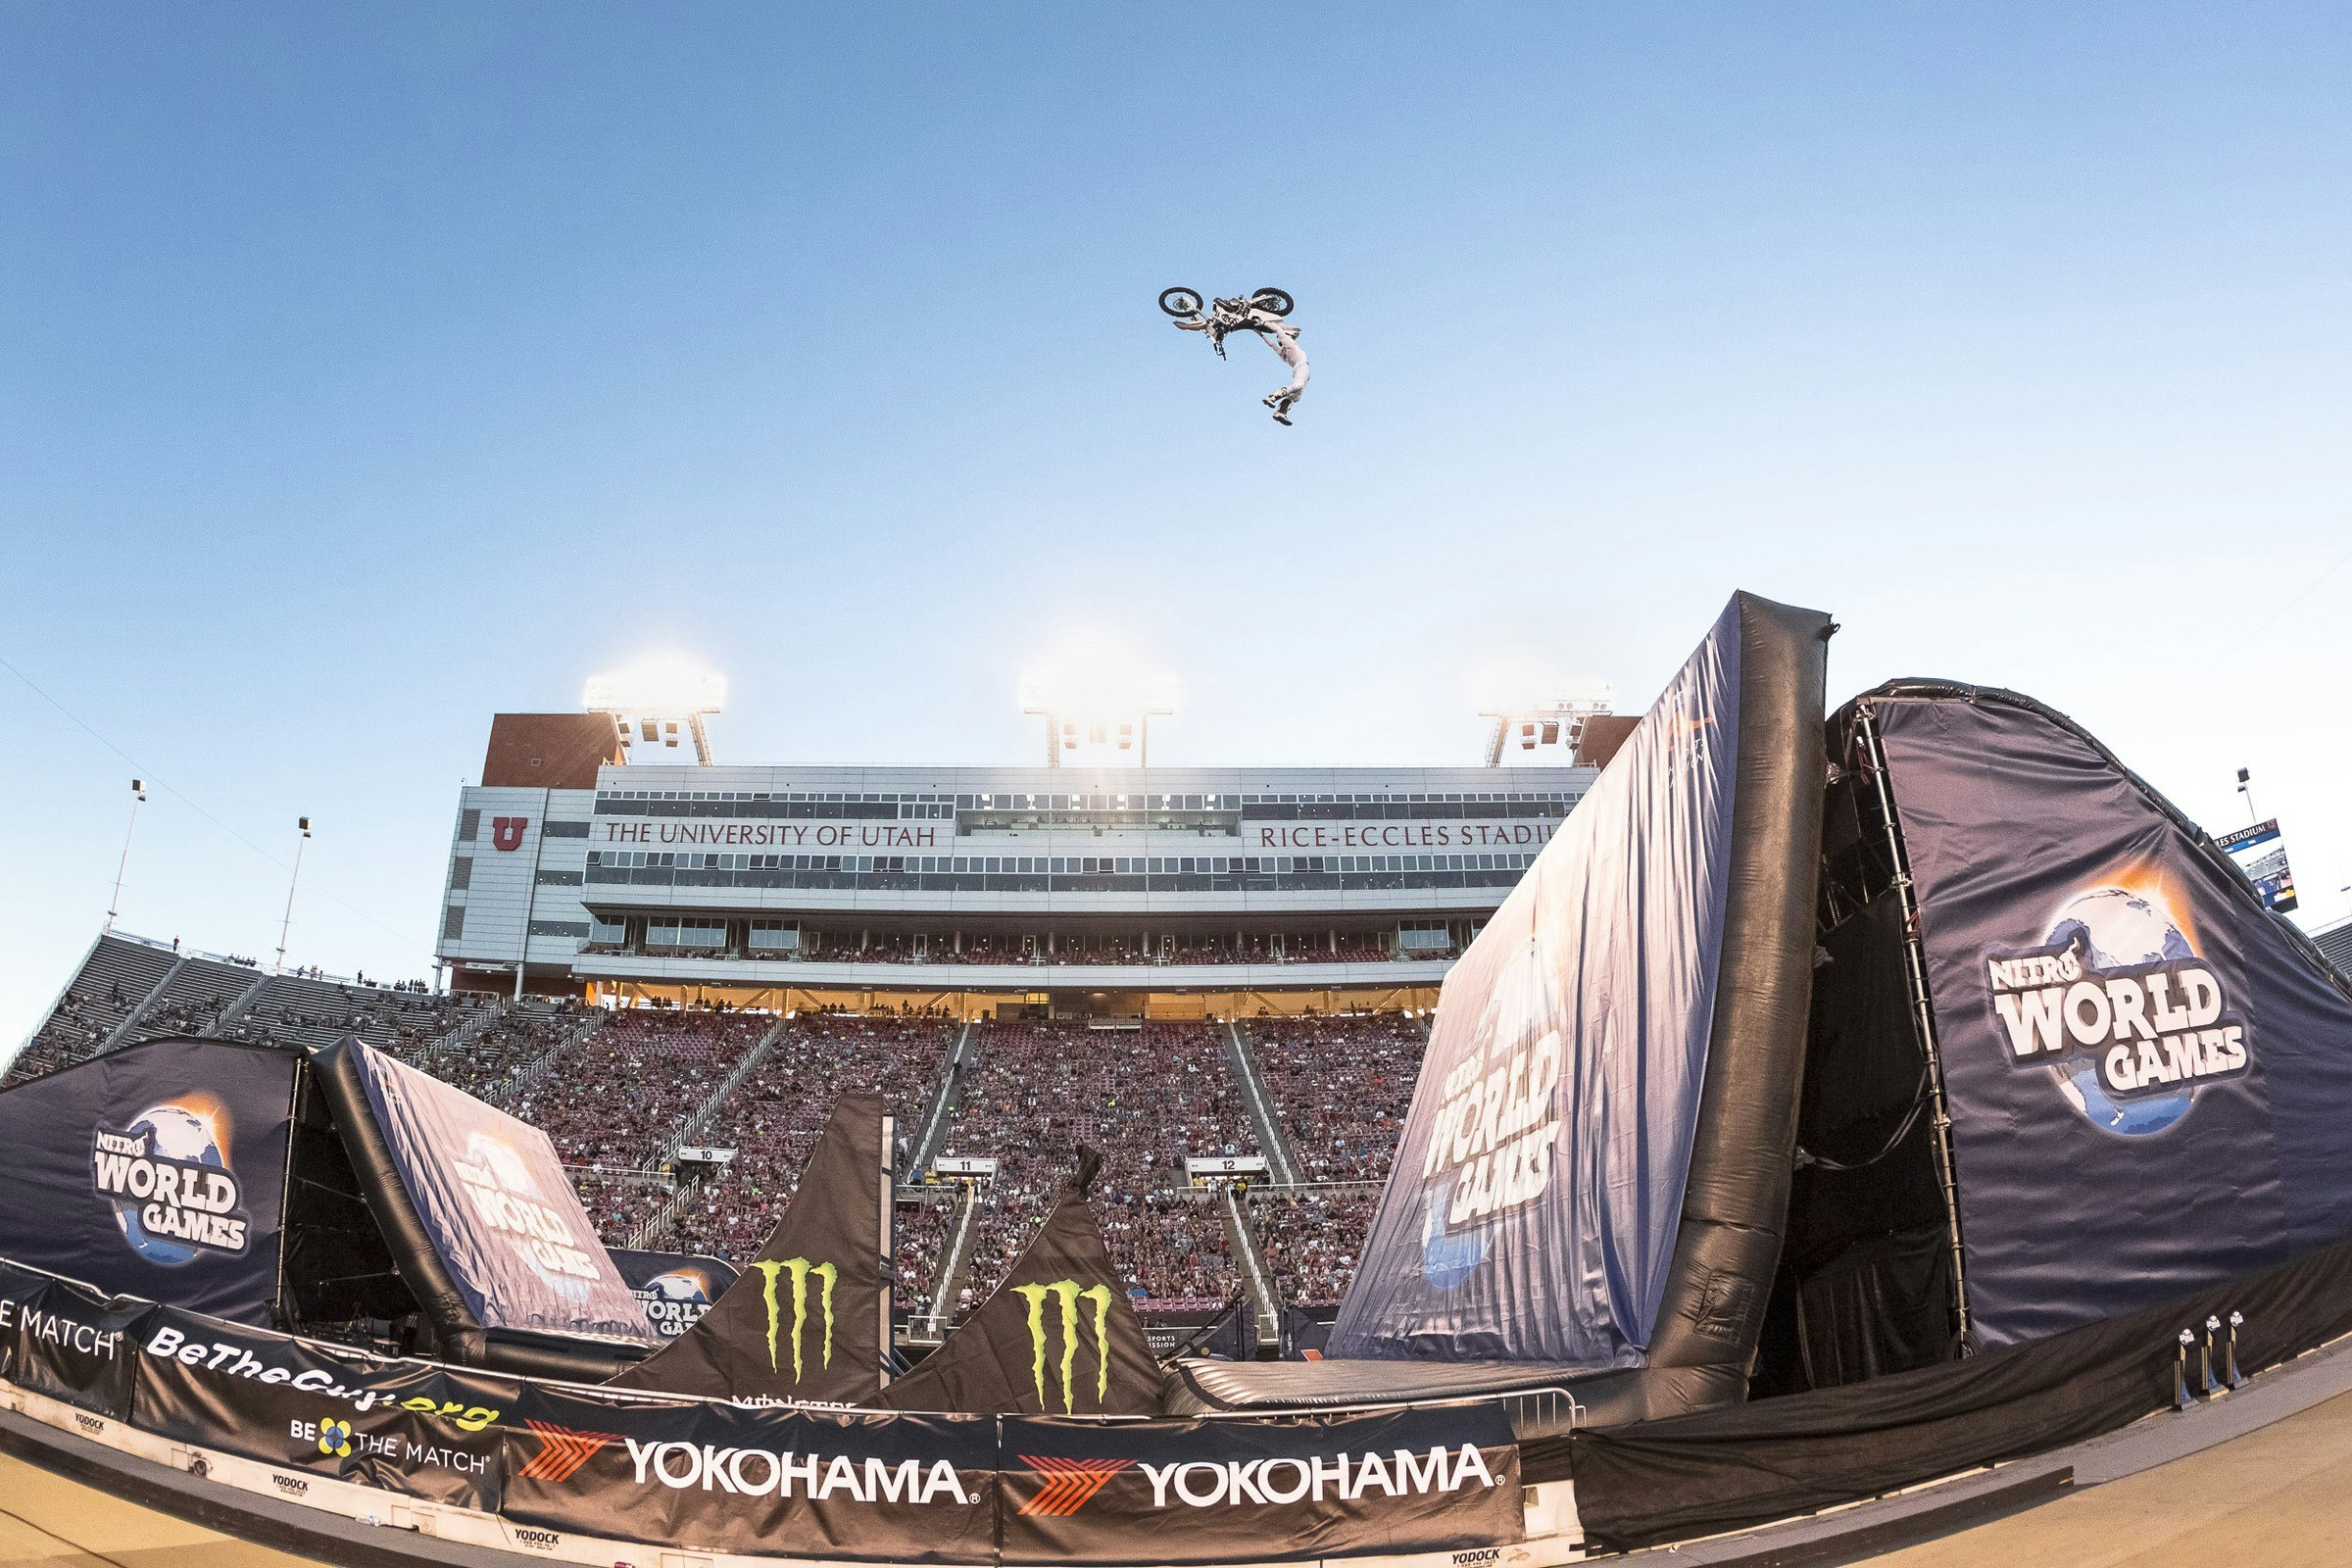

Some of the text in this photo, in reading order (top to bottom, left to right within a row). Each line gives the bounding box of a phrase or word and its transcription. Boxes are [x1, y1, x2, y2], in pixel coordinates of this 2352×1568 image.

[492, 816, 528, 852] U
[606, 822, 936, 847] THE UNIVERSITY OF UTAH
[1260, 824, 1449, 847] RICE-ECCLES
[2230, 825, 2266, 844] STADIUM
[1987, 937, 2082, 991] NITRO
[1994, 968, 2222, 1056] WORLD
[2105, 1026, 2247, 1091] GAMES
[1423, 1030, 1561, 1179] WORLD
[96, 1130, 149, 1157] NITRO
[700, 1150, 712, 1160] 10
[960, 1160, 971, 1171] 11
[1222, 1160, 1235, 1170] 12
[95, 1151, 237, 1214] WORLD
[142, 1203, 247, 1250] GAMES
[147, 1326, 500, 1432] BeTheGuy.org
[75, 1412, 104, 1431] YODOCK
[290, 1419, 317, 1442] BE
[355, 1433, 398, 1457] THE
[272, 1473, 309, 1492] YODOCK
[514, 1529, 560, 1544] YODOCK
[1451, 1548, 1500, 1565] YODOCK
